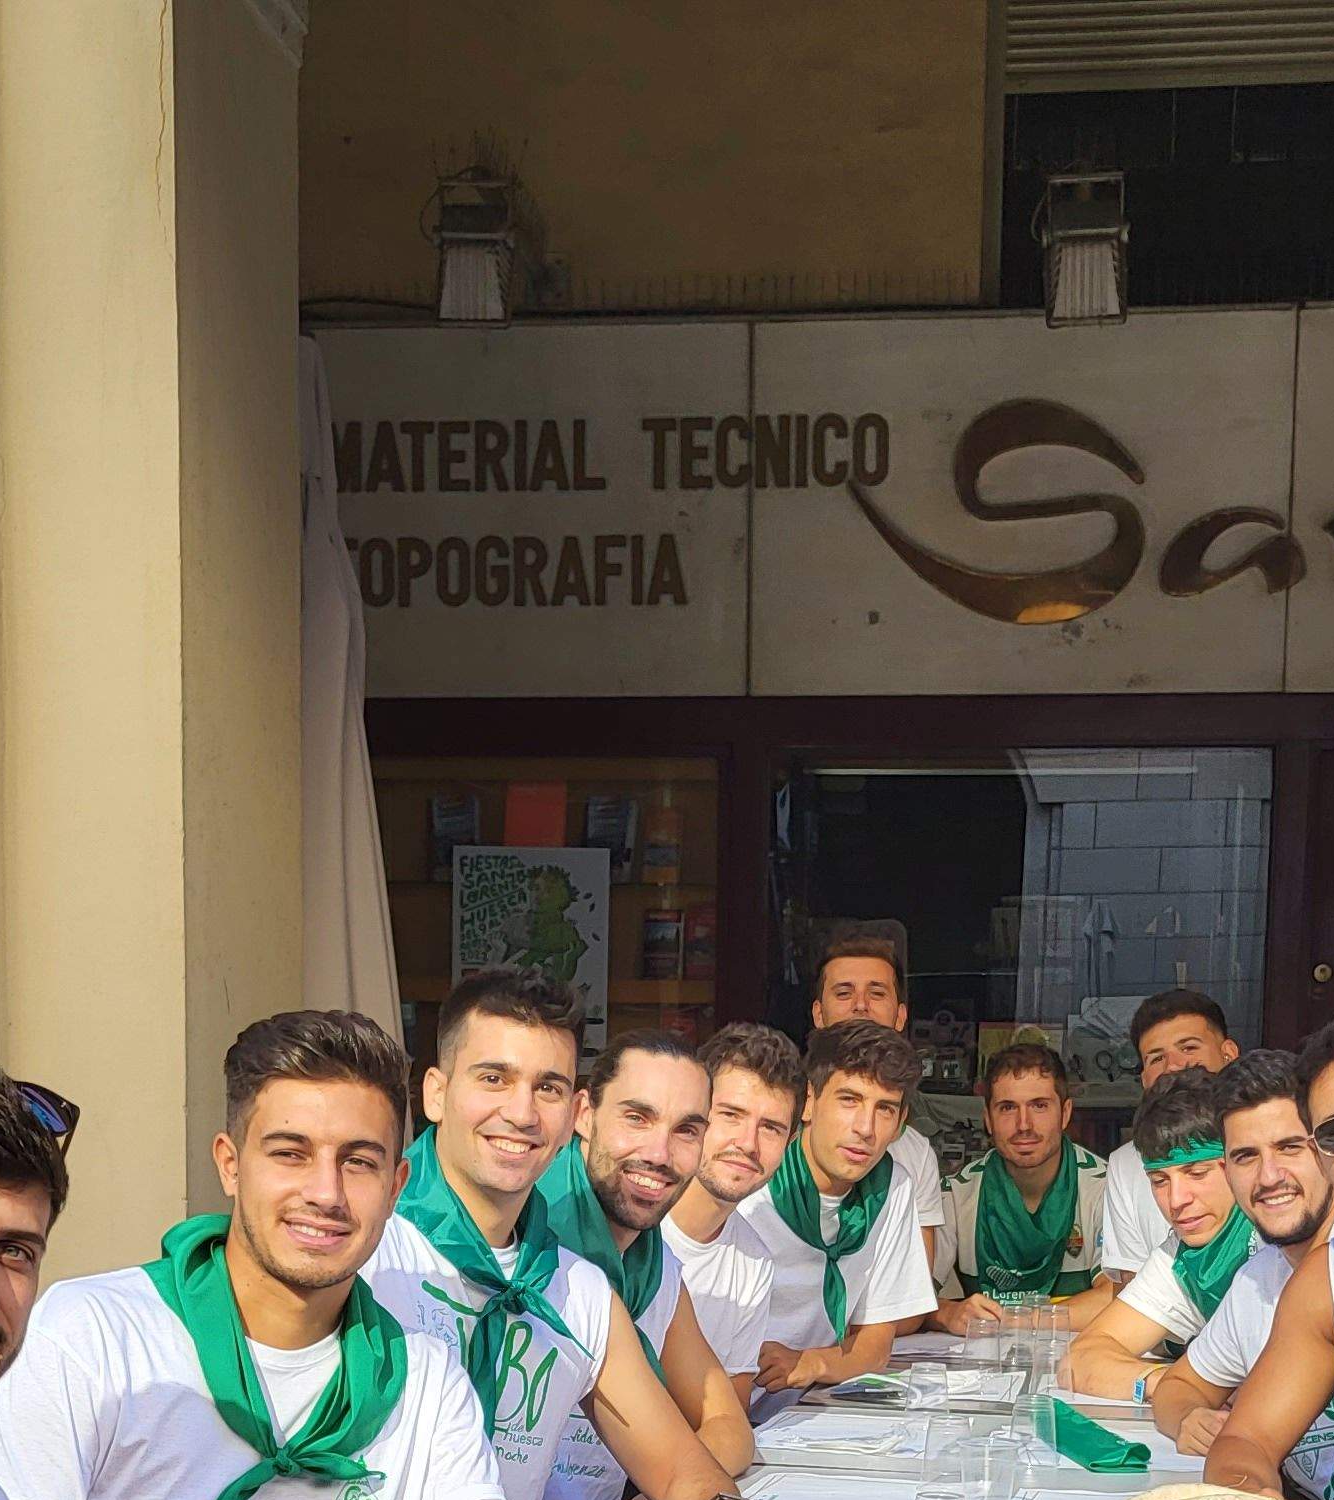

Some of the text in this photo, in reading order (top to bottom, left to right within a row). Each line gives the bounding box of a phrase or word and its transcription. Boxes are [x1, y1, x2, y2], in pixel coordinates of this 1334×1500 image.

[331, 412, 890, 493] MATERIAL TECNICO
[344, 532, 689, 608] OPOGRAFIA
